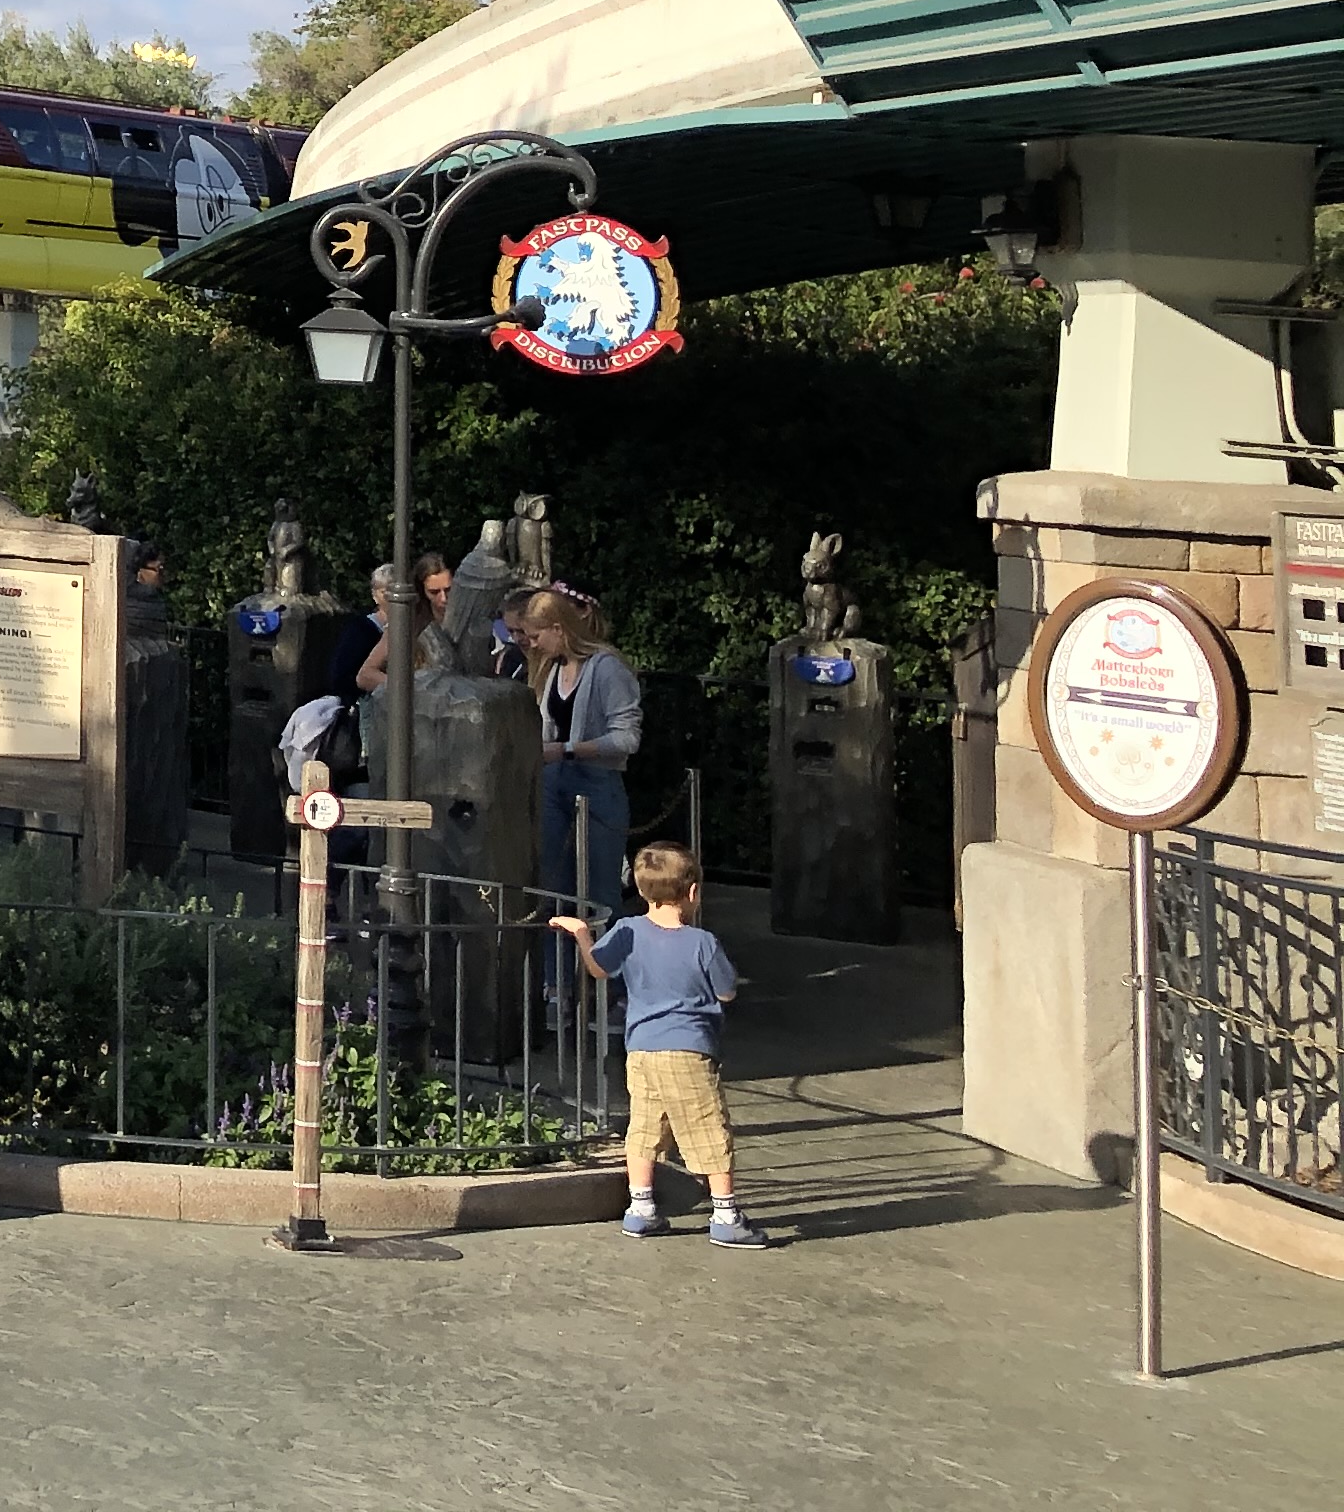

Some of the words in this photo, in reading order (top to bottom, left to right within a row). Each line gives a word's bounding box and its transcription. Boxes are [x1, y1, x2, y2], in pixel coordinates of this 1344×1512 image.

[527, 217, 643, 251] FASTPASS
[514, 332, 662, 371] DISTRIBUTION
[1091, 659, 1174, 678] Matterhorn
[1100, 674, 1165, 692] Bobsleds
[1101, 715, 1108, 724] a
[1111, 716, 1143, 729] small
